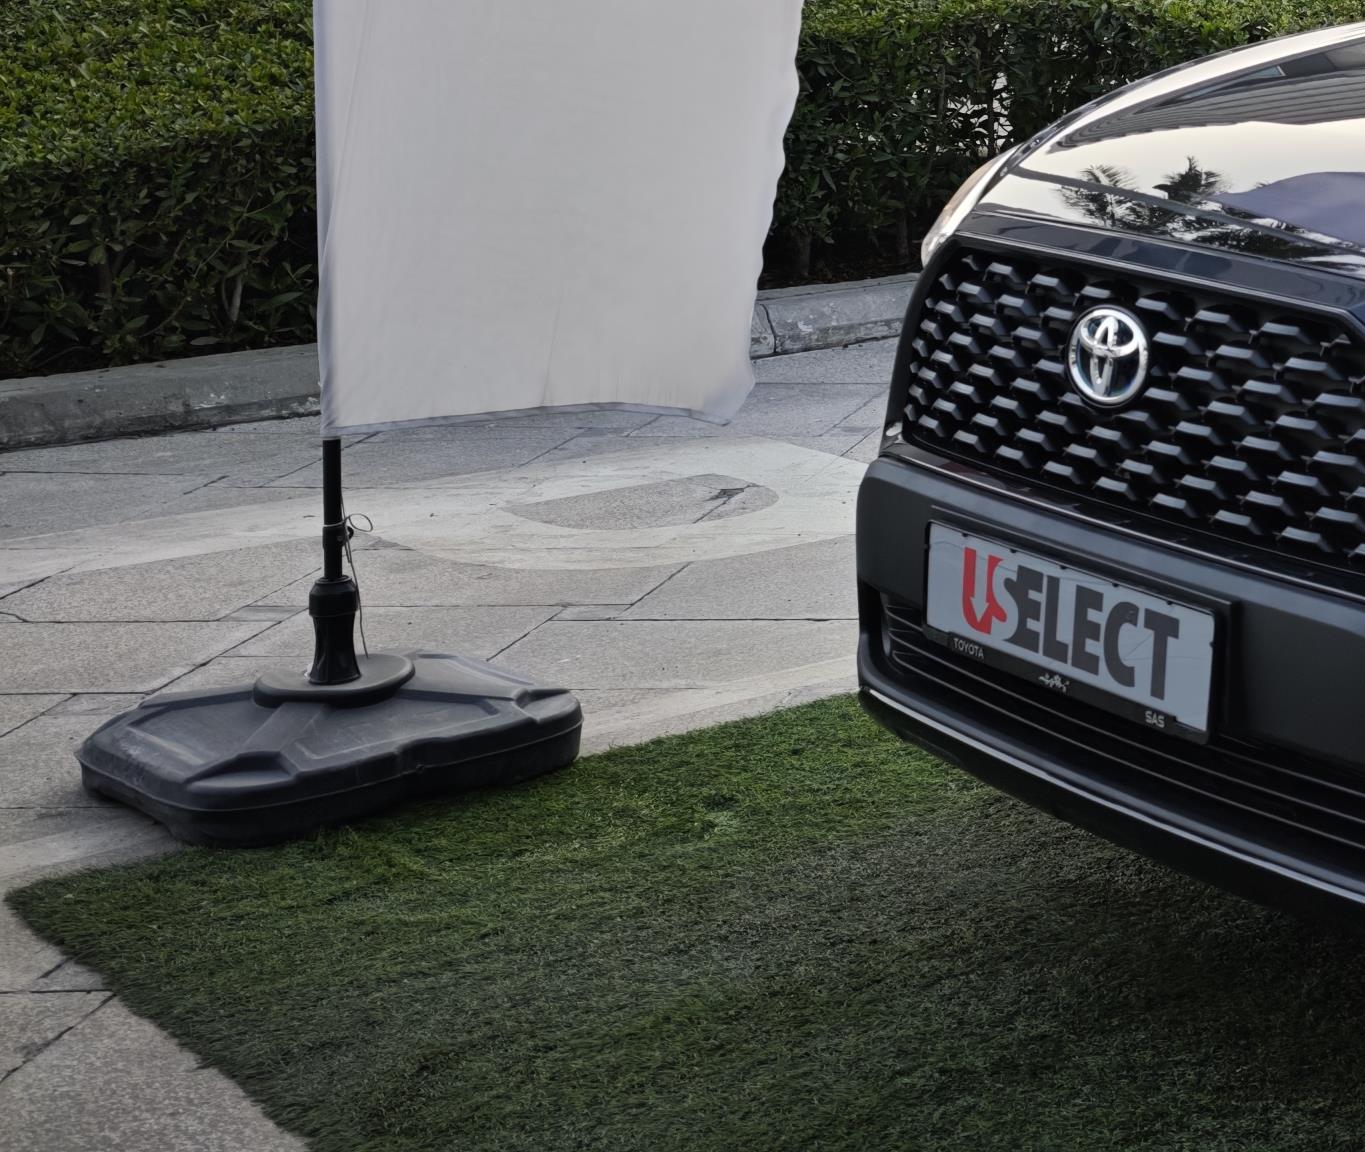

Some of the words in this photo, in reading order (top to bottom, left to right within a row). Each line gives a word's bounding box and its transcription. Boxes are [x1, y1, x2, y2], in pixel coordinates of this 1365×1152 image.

[962, 546, 1180, 701] USELECT
[953, 637, 985, 660] TOYOTA
[1145, 710, 1165, 729] SAS
